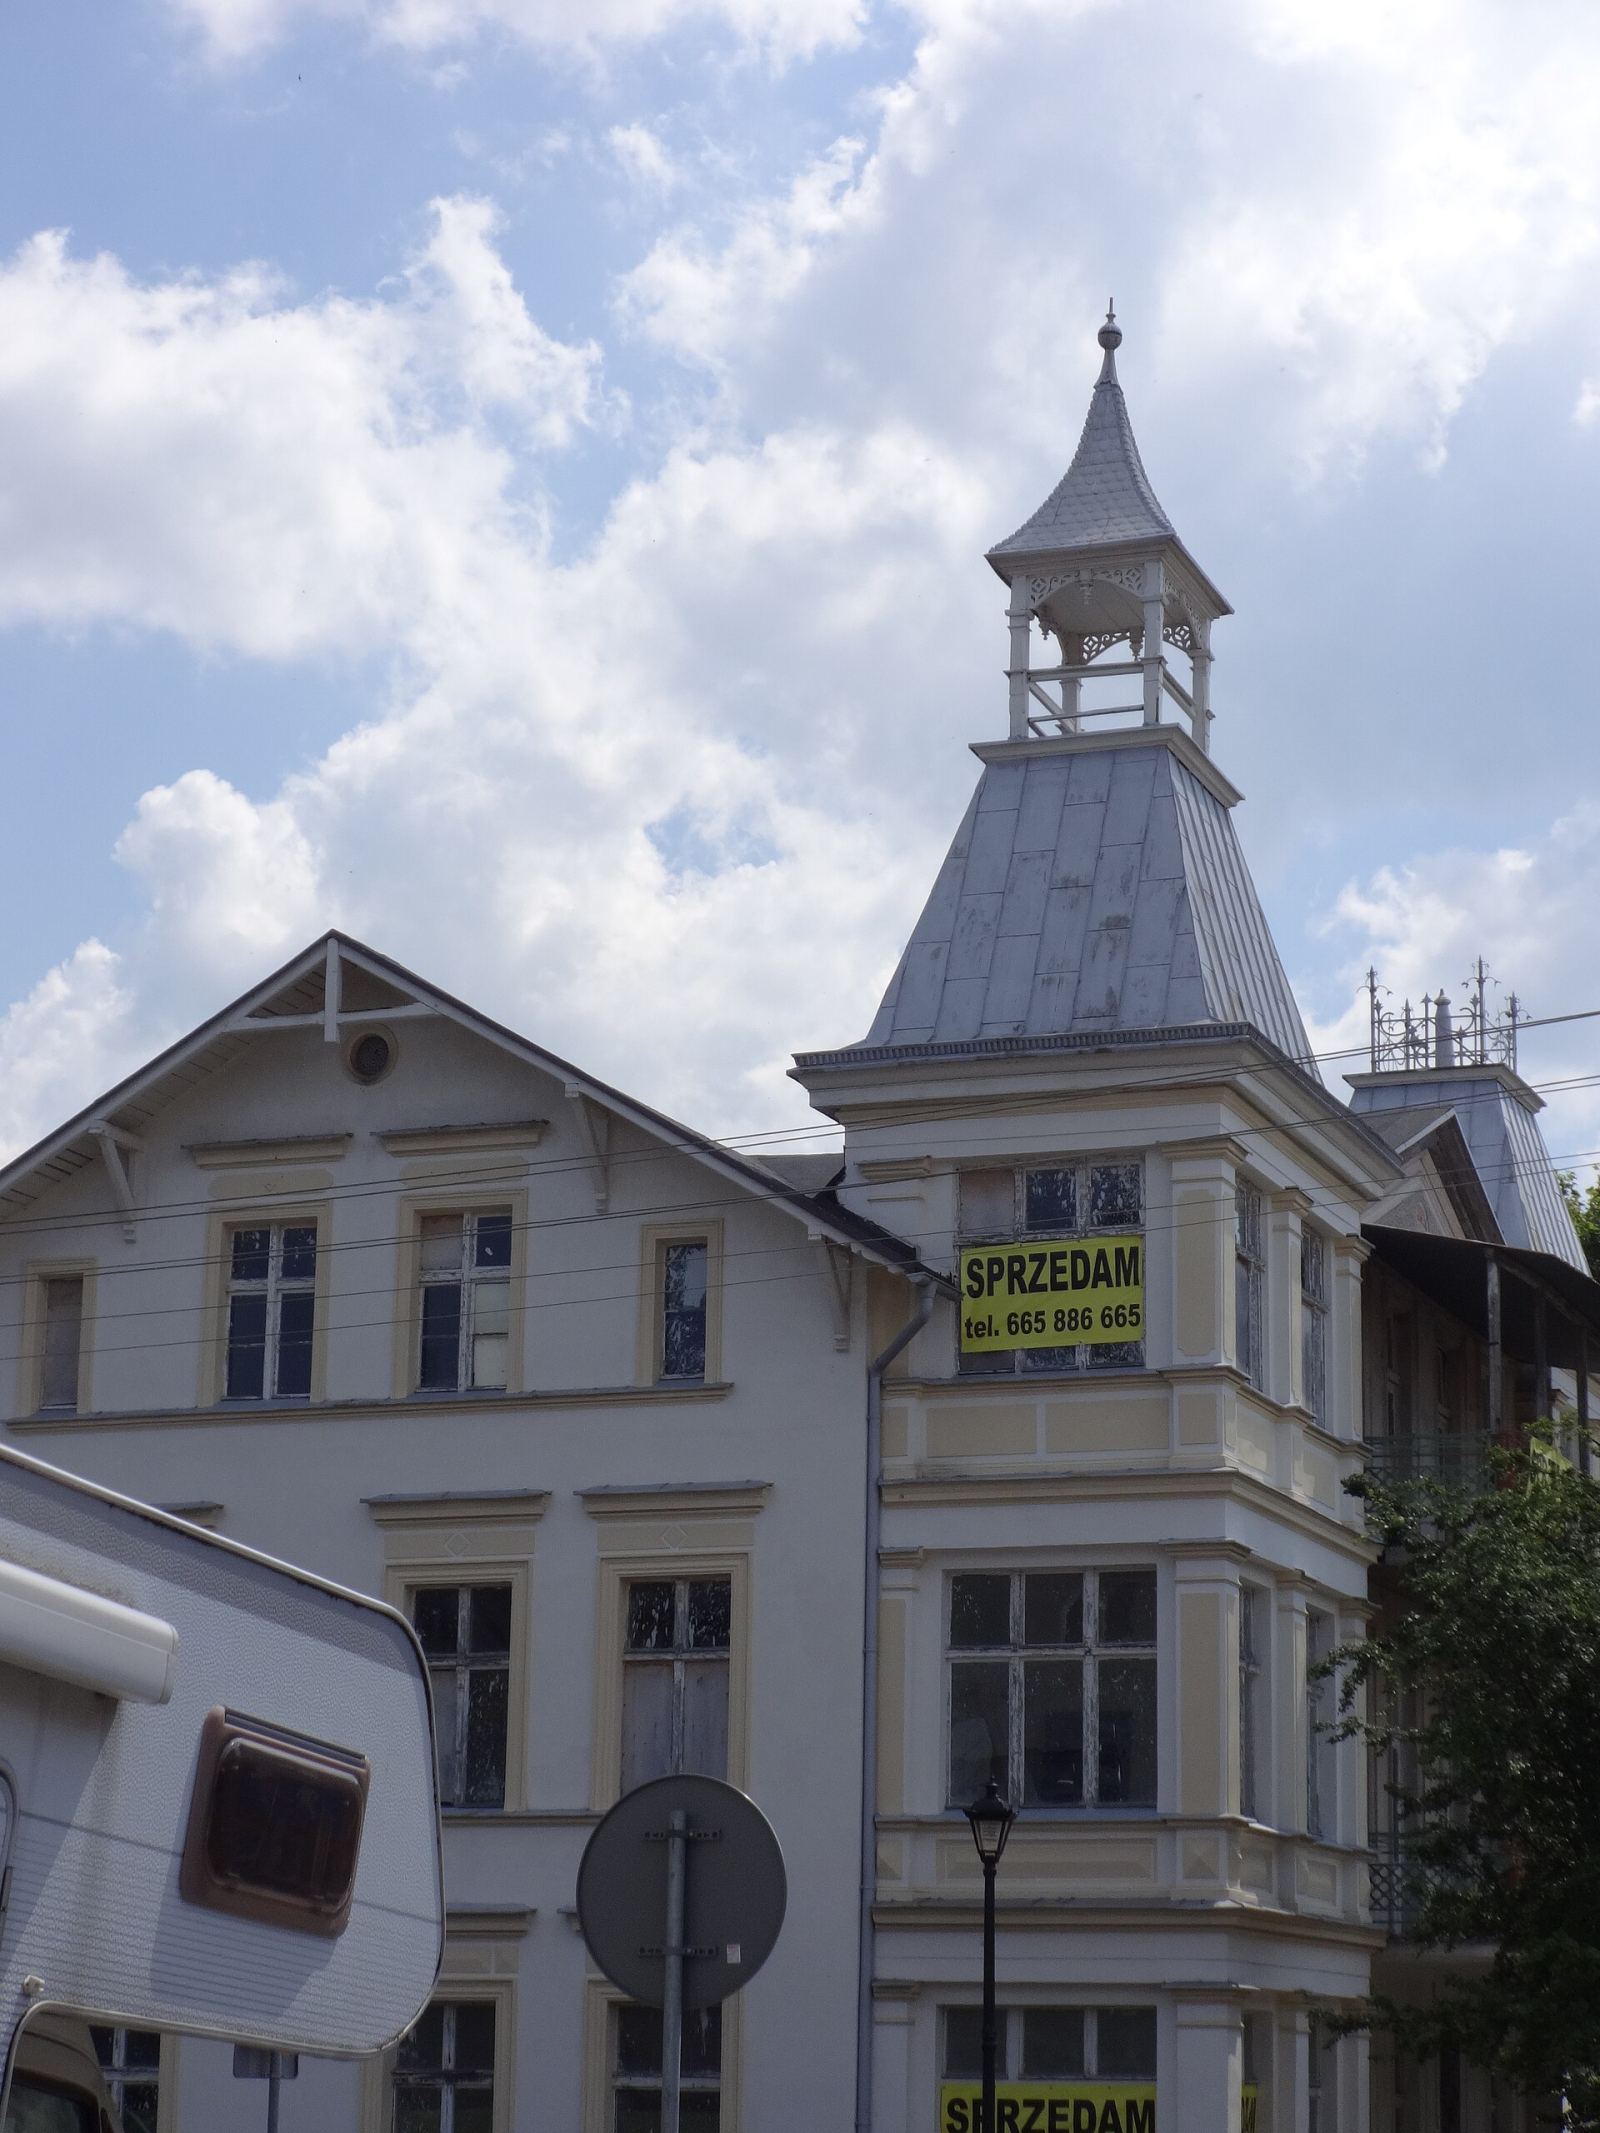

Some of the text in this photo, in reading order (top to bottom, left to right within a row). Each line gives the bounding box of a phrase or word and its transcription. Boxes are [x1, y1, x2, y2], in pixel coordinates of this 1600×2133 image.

[966, 1246, 1140, 1298] SPRZEDAM
[965, 1304, 1141, 1338] tel. 665 886 665
